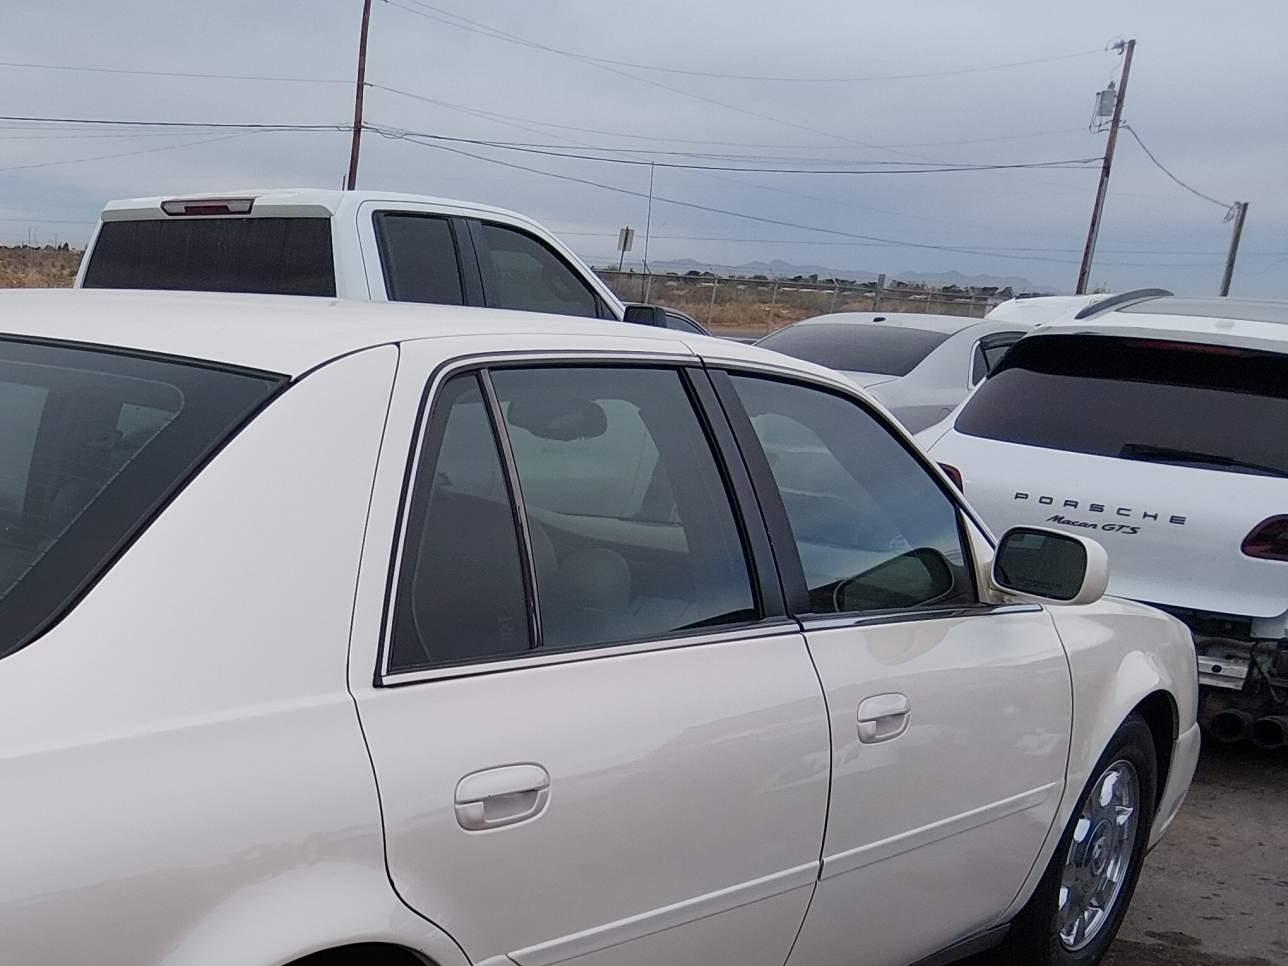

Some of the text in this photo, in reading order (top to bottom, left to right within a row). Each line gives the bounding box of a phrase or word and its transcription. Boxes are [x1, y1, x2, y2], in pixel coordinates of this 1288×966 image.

[1014, 492, 1187, 525] PORSCHE
[1046, 514, 1141, 535] Macan GTS
